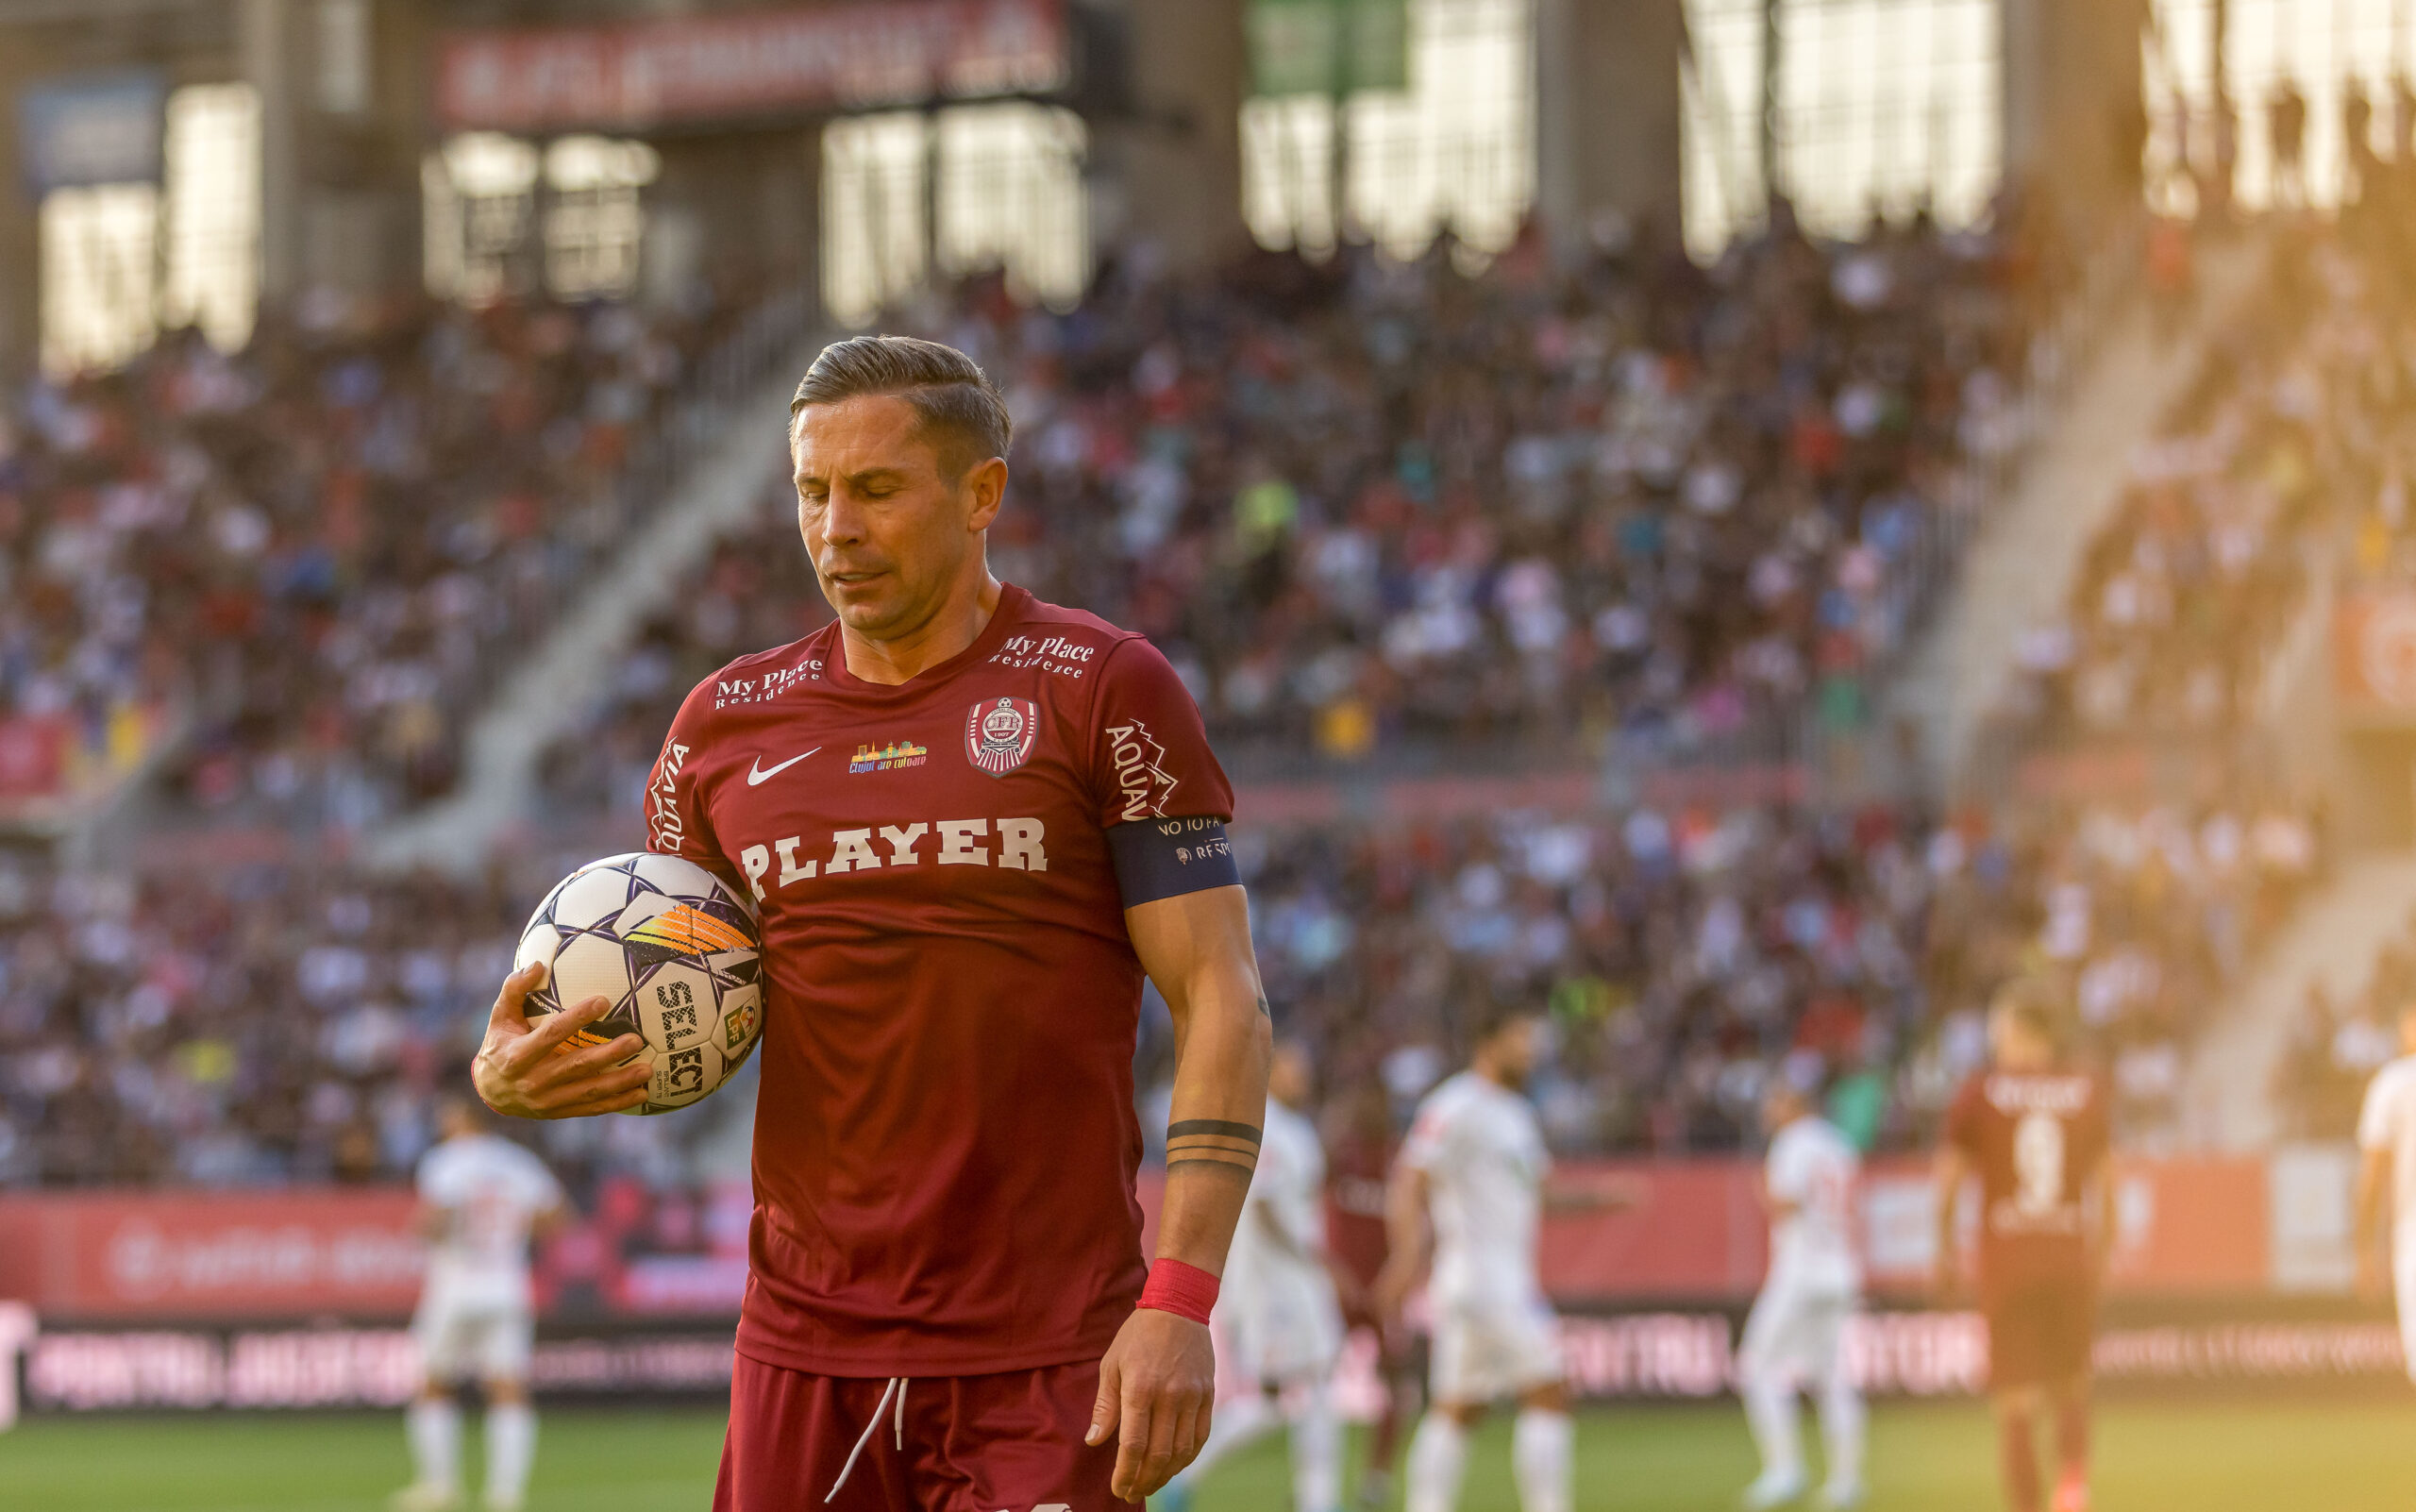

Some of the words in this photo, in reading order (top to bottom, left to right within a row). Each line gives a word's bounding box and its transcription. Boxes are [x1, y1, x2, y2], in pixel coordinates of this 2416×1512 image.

[988, 654, 1082, 679] Residence
[998, 635, 1037, 656] My
[1036, 636, 1095, 663] Place
[714, 673, 820, 711] Residence
[715, 679, 757, 697] My
[763, 659, 823, 691] Place
[984, 716, 1021, 730] CFR
[877, 761, 892, 771] are
[1105, 725, 1150, 822] AQUAV
[660, 743, 691, 855] QUAVIA
[740, 816, 1049, 903] PLAYER
[656, 981, 703, 1098] SELECT
[728, 1014, 740, 1043] LPF
